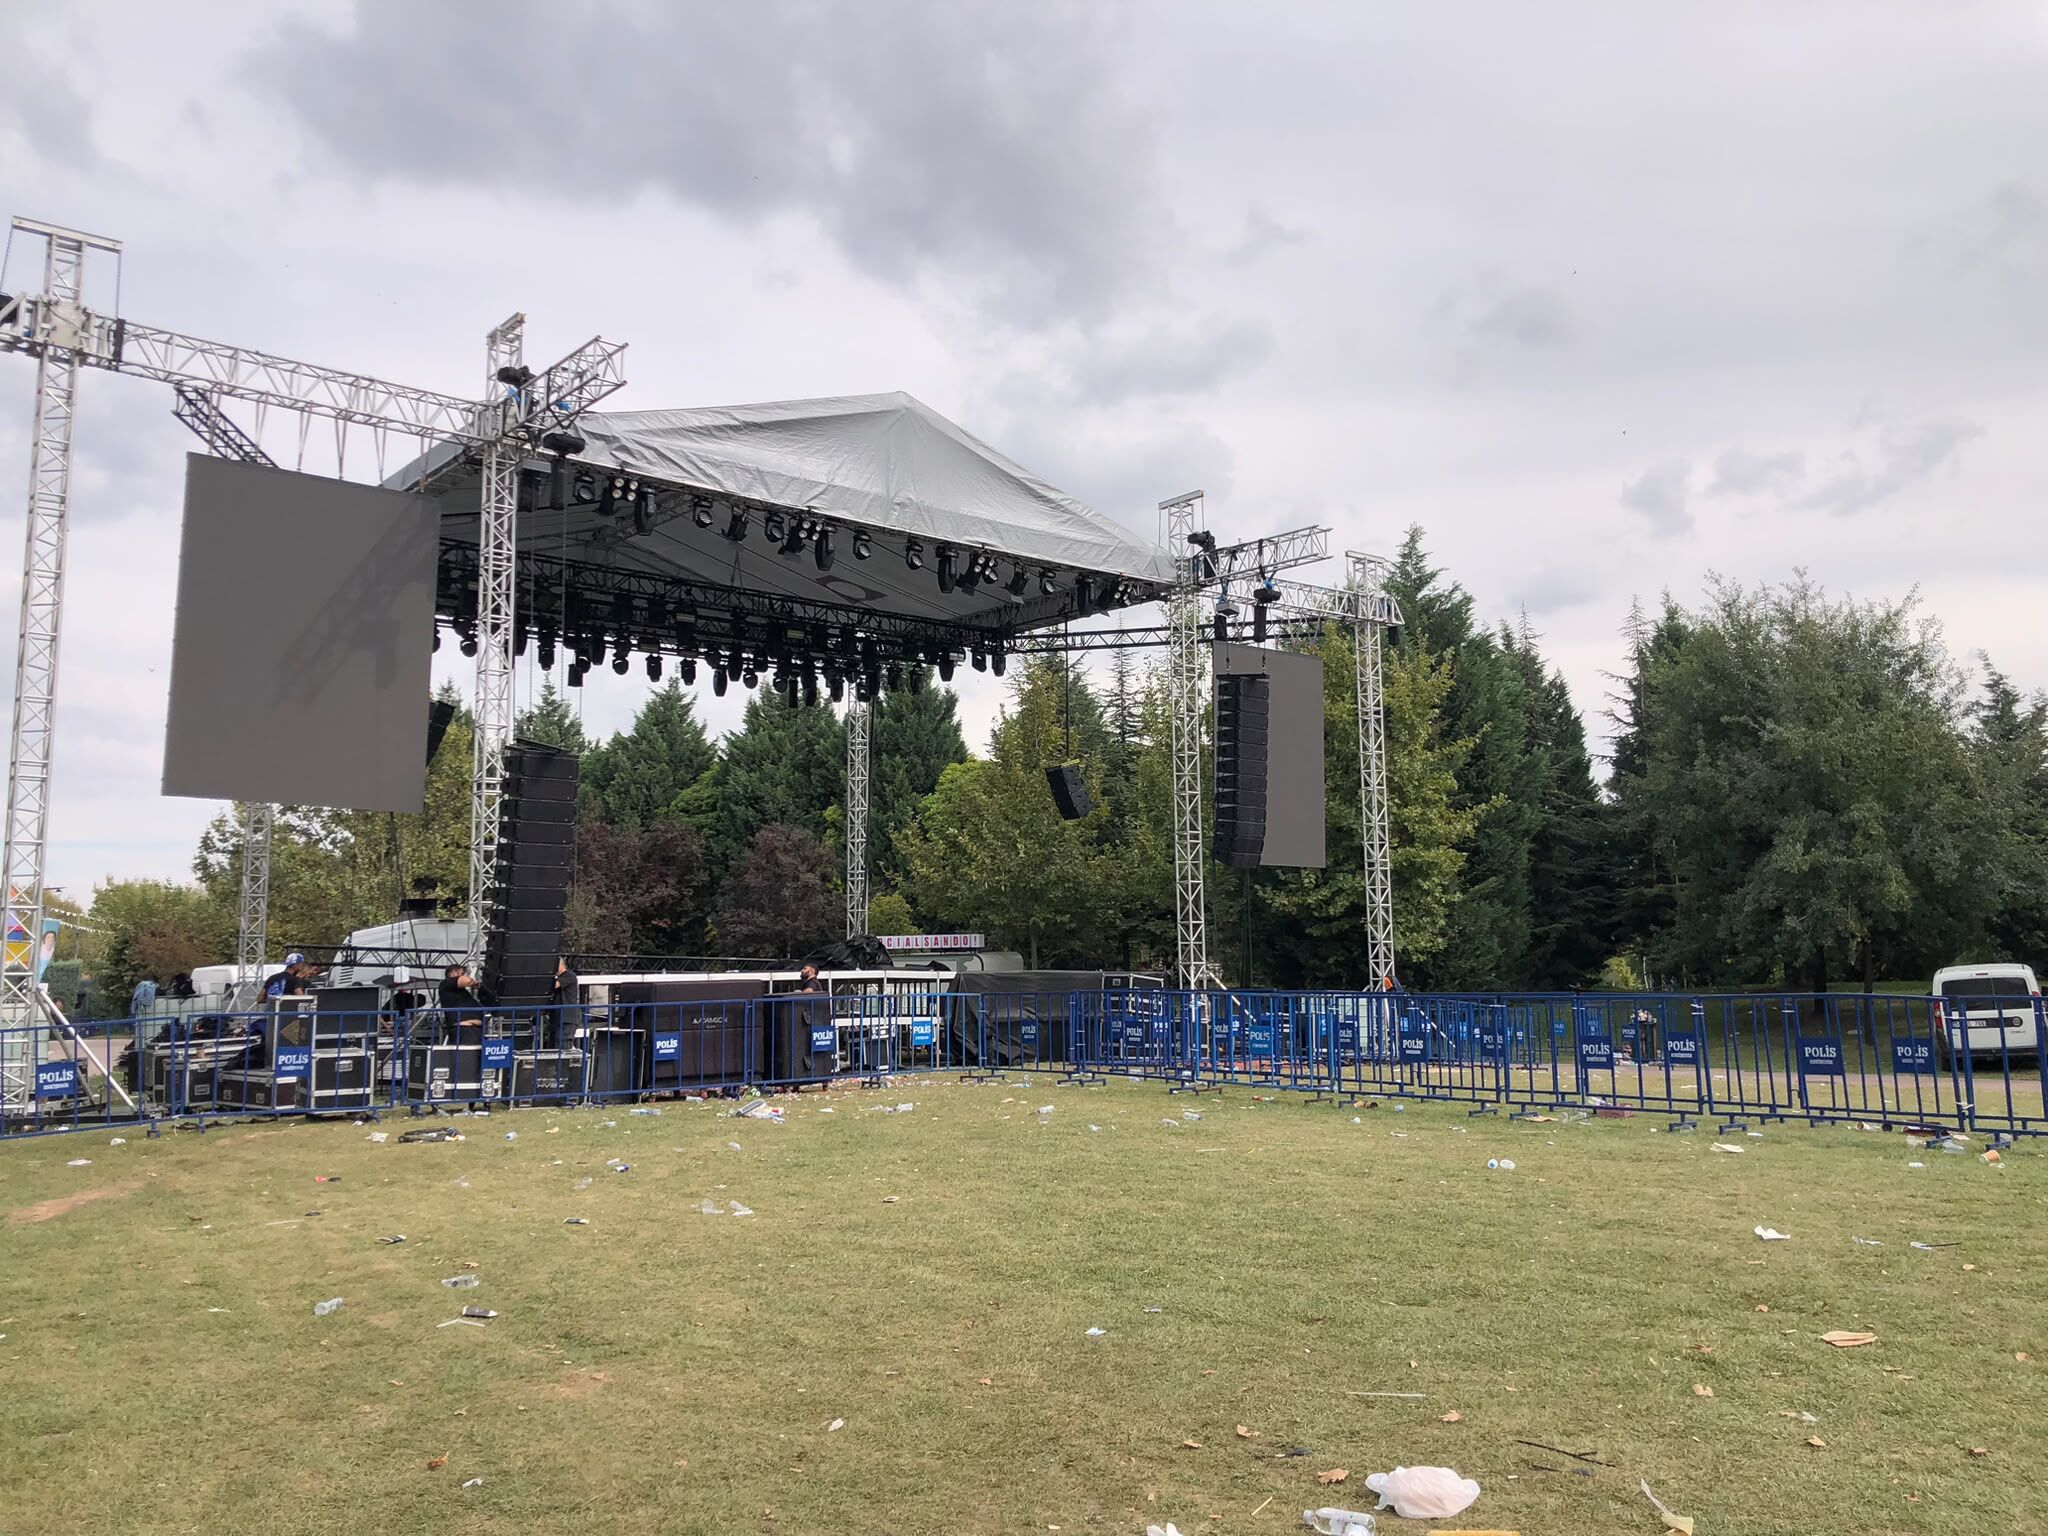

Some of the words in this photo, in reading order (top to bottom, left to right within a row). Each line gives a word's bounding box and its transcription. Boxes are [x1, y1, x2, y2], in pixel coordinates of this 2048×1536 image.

[879, 936, 977, 948] CIALSANDO!
[913, 1025, 931, 1034] POLİS
[1126, 1026, 1143, 1037] POLİS
[813, 1030, 834, 1041] POLİS
[1483, 1033, 1503, 1044] POİS
[656, 1038, 679, 1049] POLİS
[1403, 1037, 1424, 1049] POLİS
[1582, 1042, 1610, 1055] POLİS
[1667, 1038, 1695, 1051] POLİS
[485, 1044, 509, 1055] POLİS
[1804, 1045, 1836, 1057] POLİS
[278, 1053, 309, 1064] POLİS
[39, 1069, 74, 1083] POLİS
